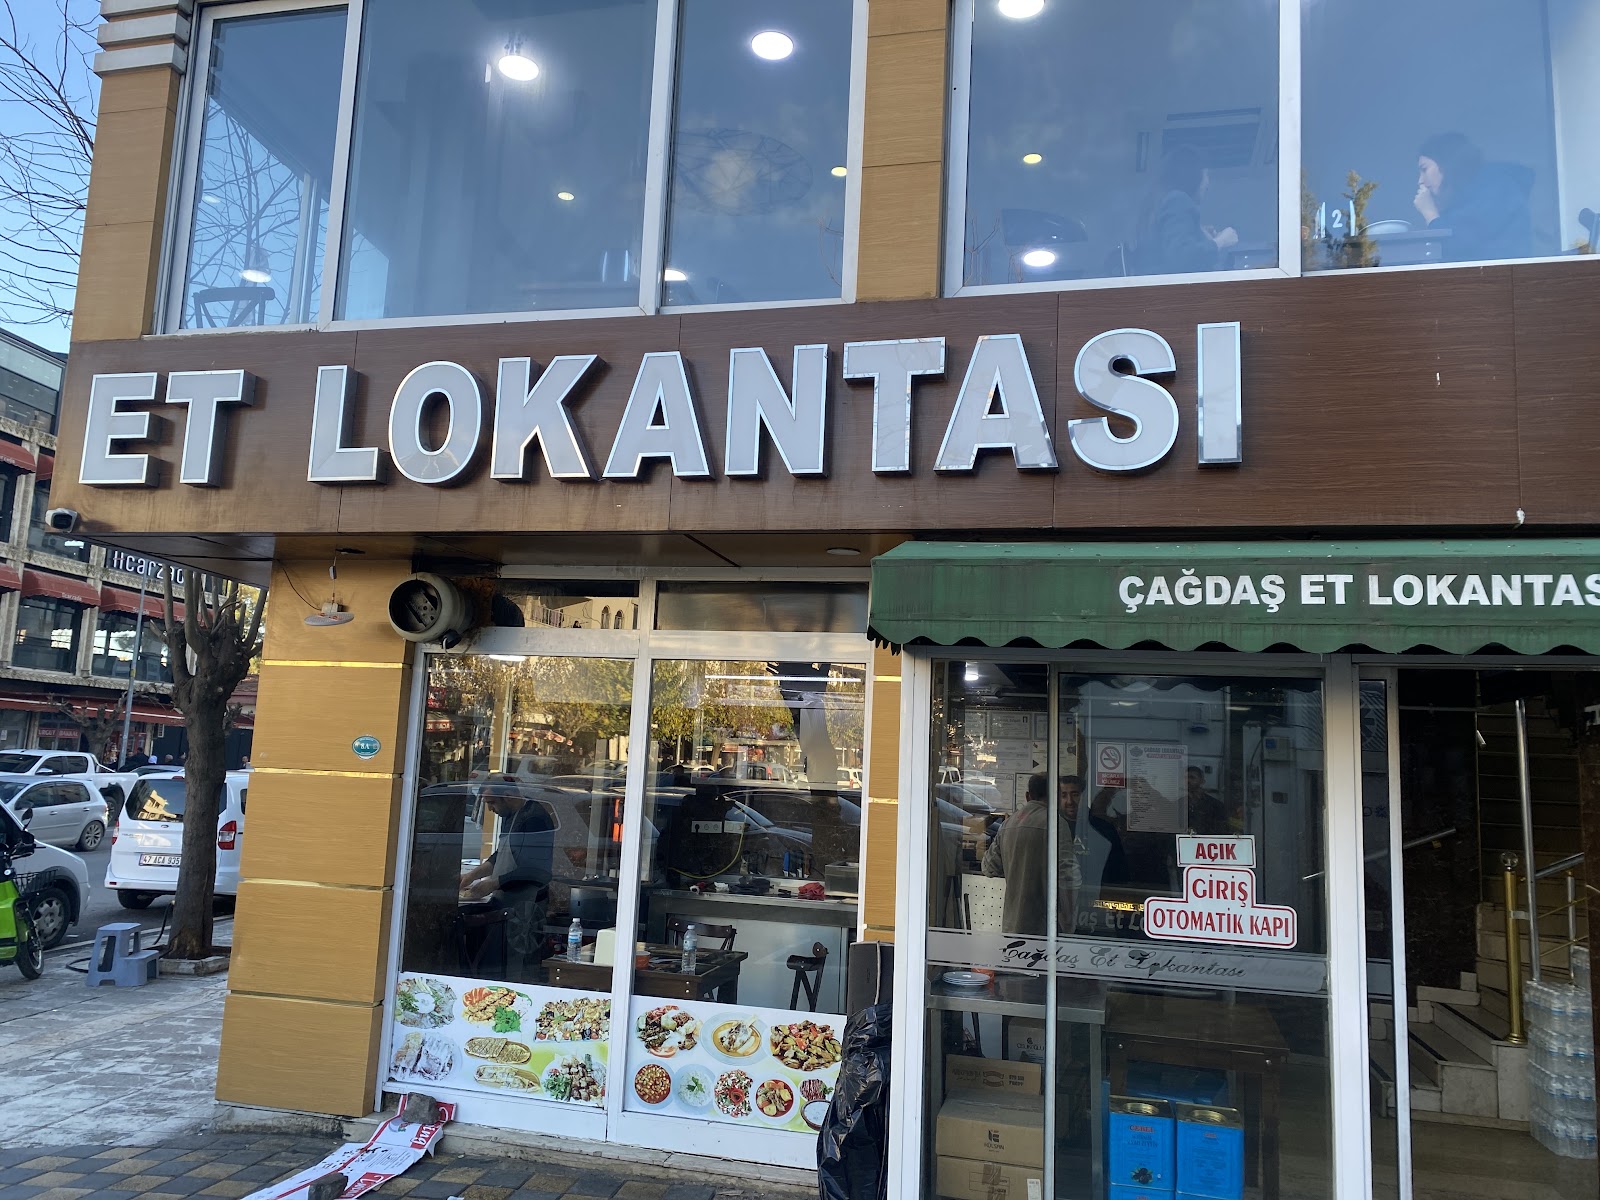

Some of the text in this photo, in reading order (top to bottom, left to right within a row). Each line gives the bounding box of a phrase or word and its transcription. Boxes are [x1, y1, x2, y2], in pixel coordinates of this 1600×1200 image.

[1331, 209, 1343, 228] 2
[79, 321, 1243, 486] ET LOKANTASI
[1118, 568, 1287, 613] ÇAĞDAŞ
[1301, 574, 1354, 605] ET
[143, 855, 180, 865] 47 ACA 935
[1195, 842, 1237, 862] AÇIK
[1192, 874, 1248, 907] GİRİŞ
[1153, 908, 1289, 937] OTOMATİK KAPI
[1090, 945, 1121, 968] Et
[1124, 949, 1246, 978] Lokantası
